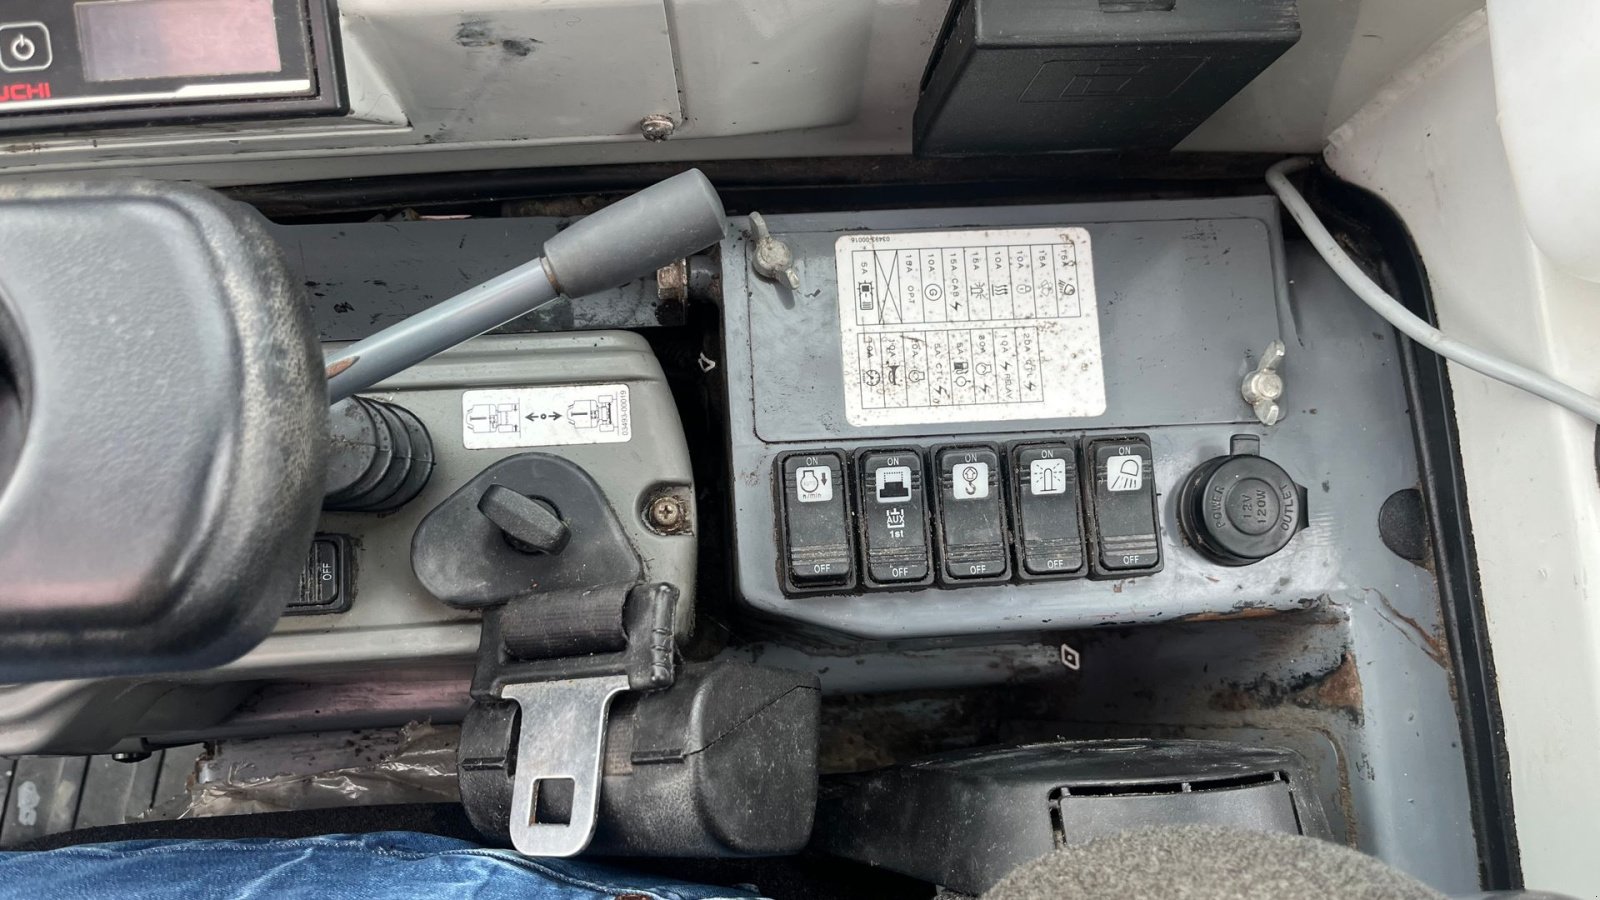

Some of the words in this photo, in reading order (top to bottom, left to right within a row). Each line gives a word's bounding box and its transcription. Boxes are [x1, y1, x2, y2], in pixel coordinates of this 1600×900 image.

[928, 254, 936, 273] 10A
[950, 253, 958, 271] 15A
[994, 251, 1002, 269] 10A
[1016, 251, 1024, 269] 10A
[1038, 250, 1046, 268] 15A
[861, 261, 868, 275] 5A
[907, 285, 915, 304] OPT
[929, 288, 938, 297] G
[951, 278, 960, 298] CAB
[911, 338, 919, 357] 0A
[935, 343, 941, 357] 5A
[1005, 374, 1013, 399] RELAY
[620, 390, 629, 436] 03493-00019
[964, 453, 978, 463] ON
[1041, 449, 1054, 459] ON
[1118, 446, 1131, 456] ON
[805, 456, 819, 466] ON
[887, 457, 899, 466] ON
[802, 492, 822, 500] n/min
[1213, 485, 1226, 529] POWER
[1242, 494, 1253, 519] 12V
[1256, 489, 1267, 524] 120W
[1279, 484, 1294, 531] OUTLET
[886, 515, 905, 524] AUX
[889, 530, 904, 539] 1st
[1047, 560, 1064, 569] OFF
[1123, 555, 1140, 565] OFF
[322, 563, 332, 580] OFF
[814, 564, 831, 574] OFF
[892, 568, 909, 577] OFF
[970, 565, 987, 575] OFF
